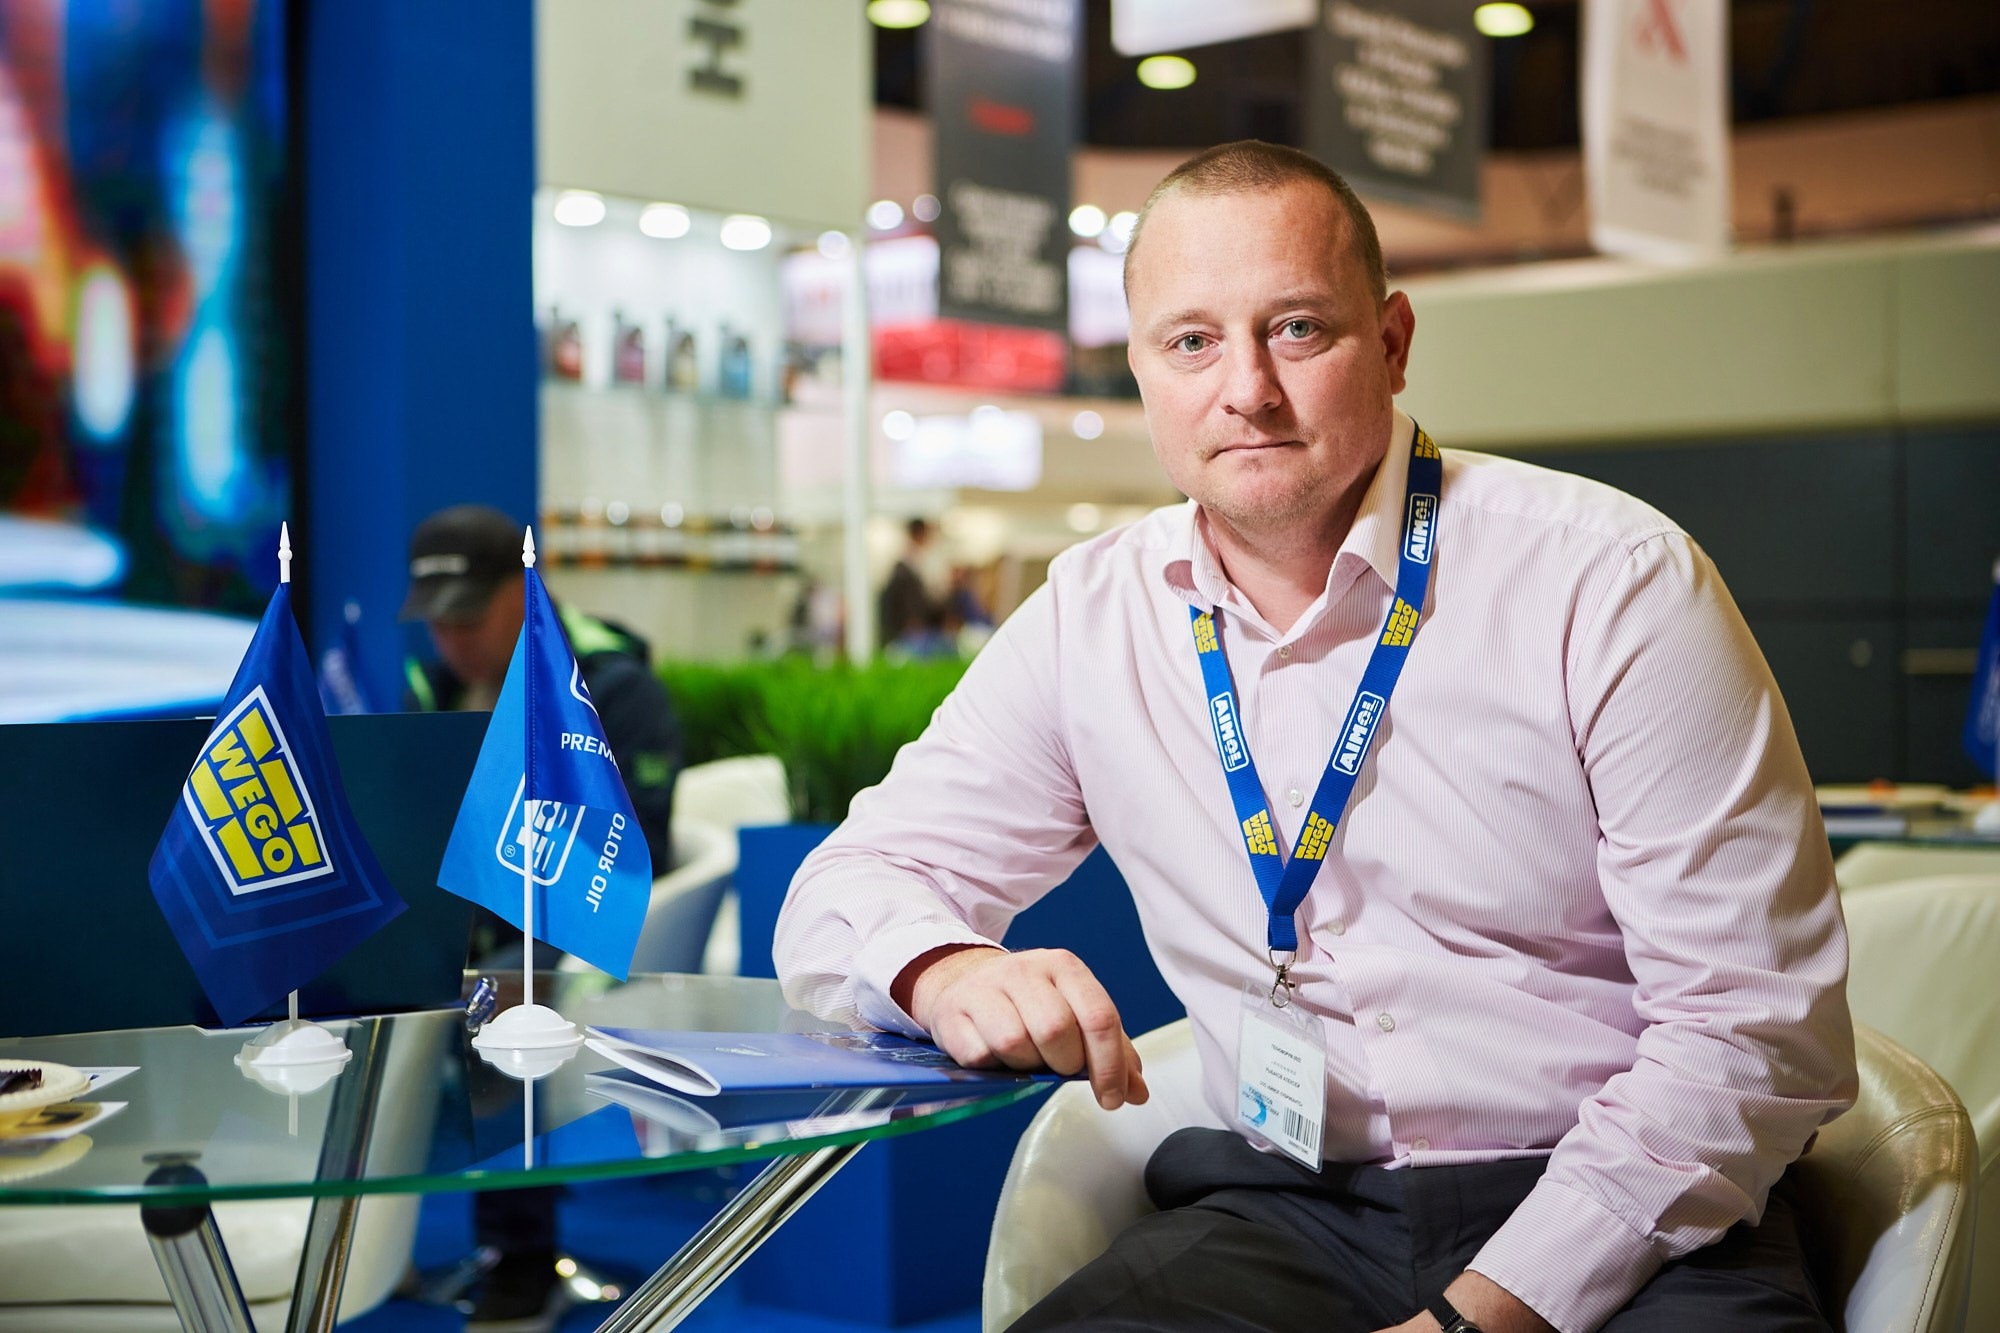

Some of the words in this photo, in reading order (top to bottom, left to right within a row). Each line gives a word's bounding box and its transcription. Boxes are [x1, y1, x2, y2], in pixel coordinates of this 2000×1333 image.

[1390, 604, 1412, 646] WEGO
[1214, 700, 1242, 767] AIMOL
[1340, 699, 1379, 771] AIMOL
[209, 730, 294, 873] WEGO
[1250, 813, 1268, 855] WEGO
[1303, 818, 1327, 859] WEGO
